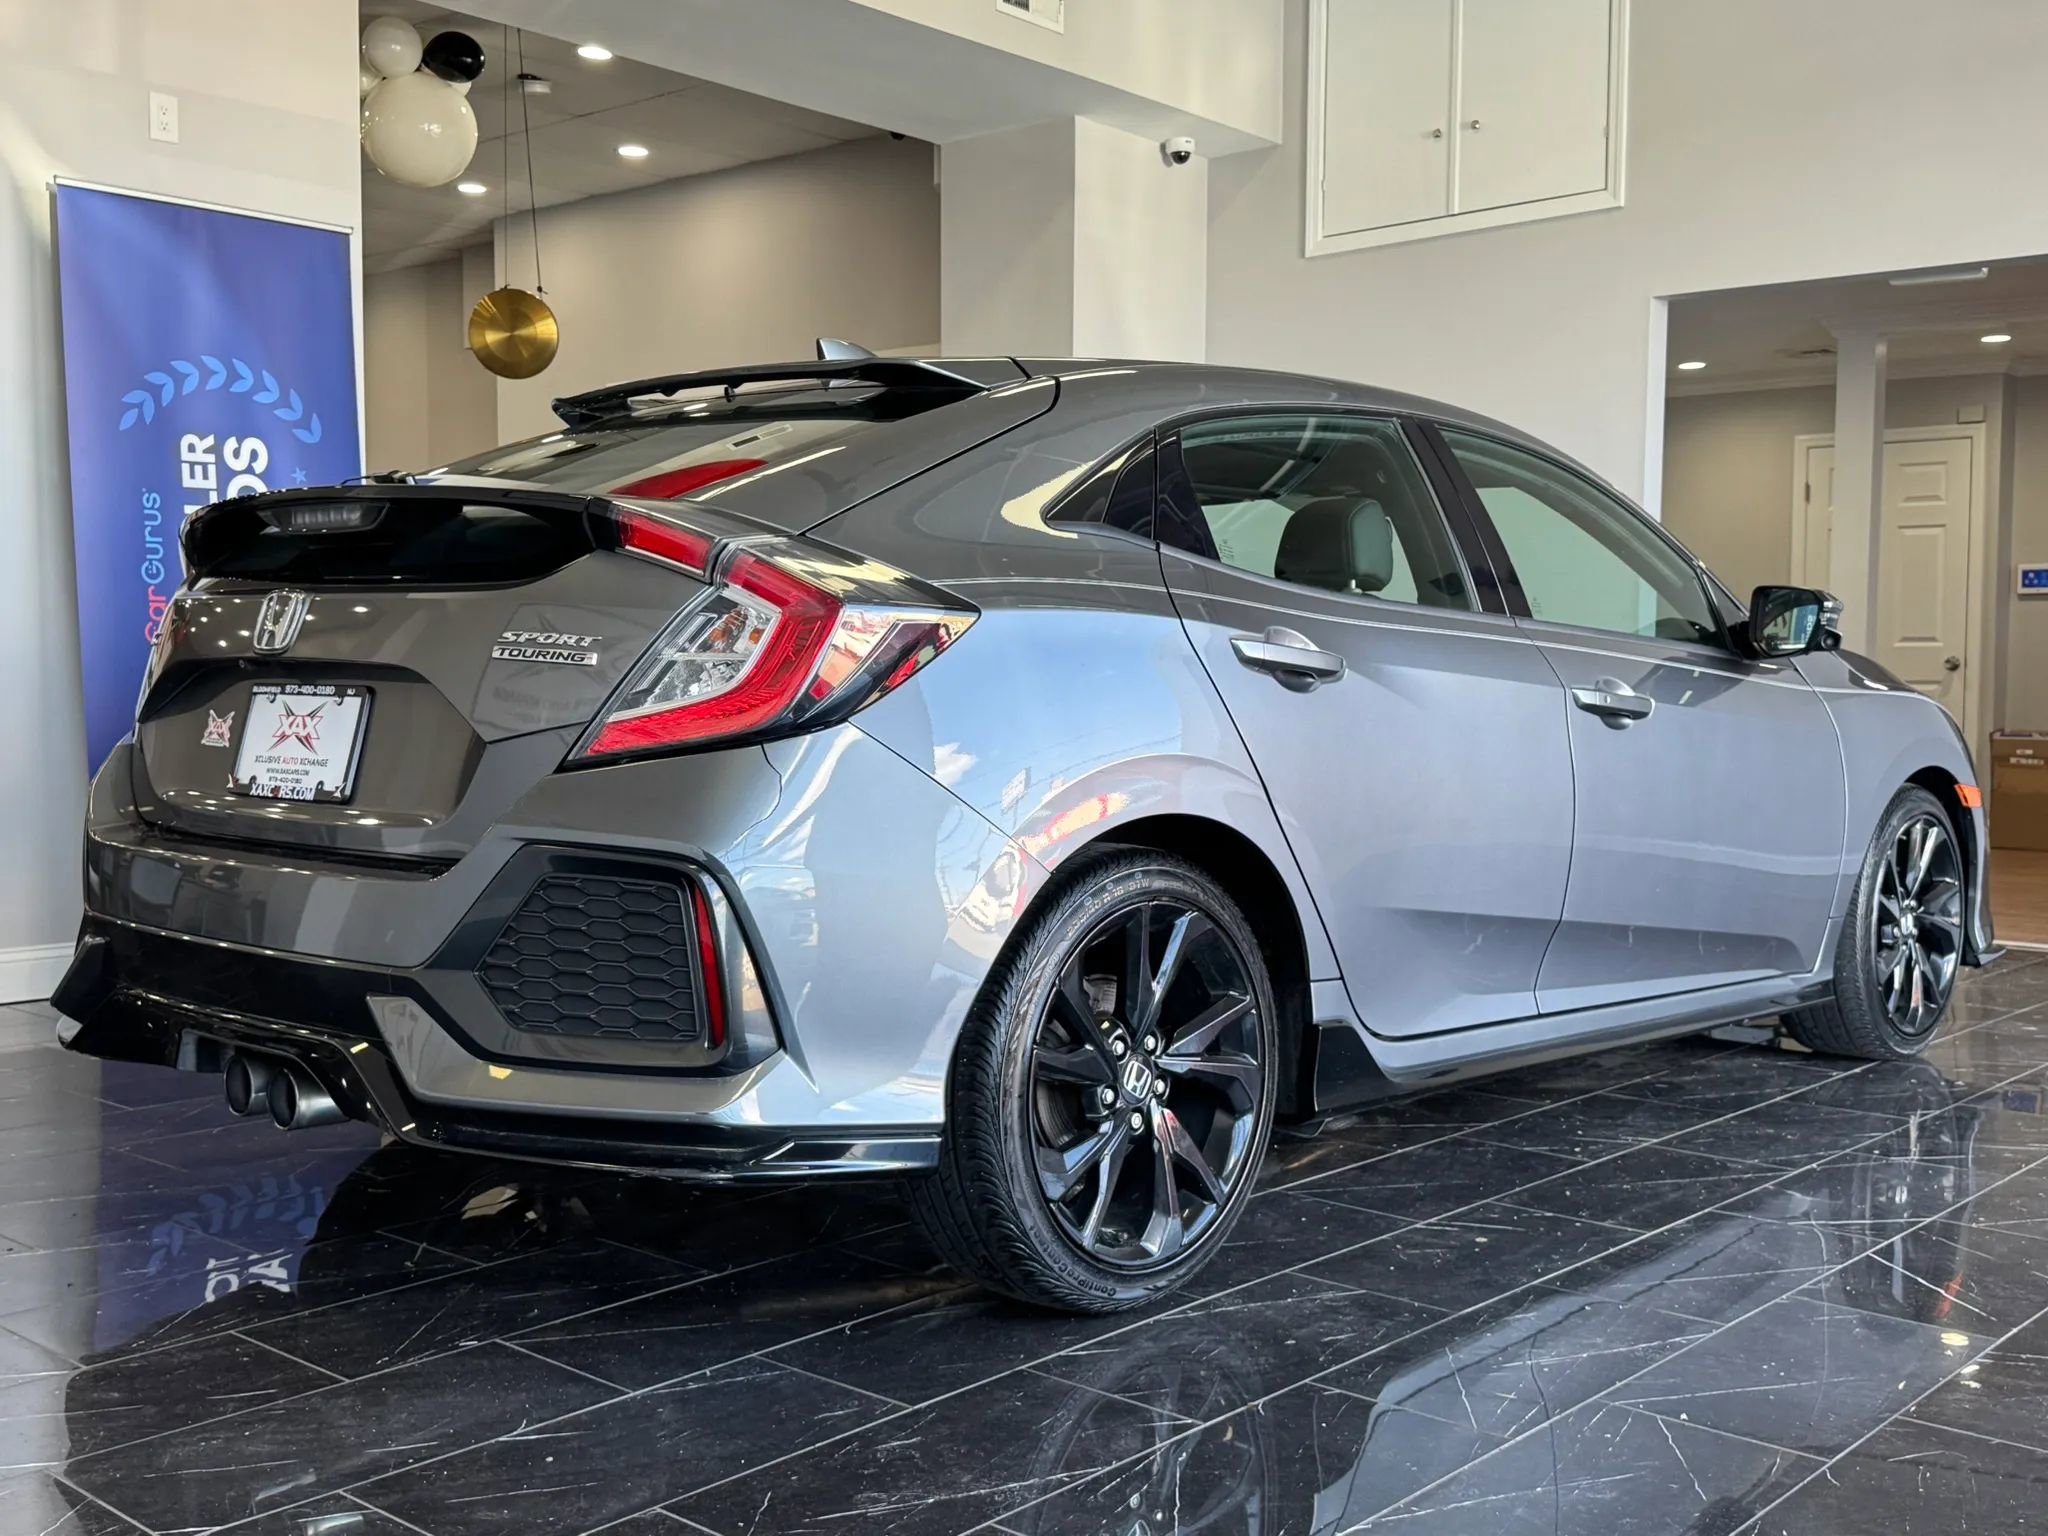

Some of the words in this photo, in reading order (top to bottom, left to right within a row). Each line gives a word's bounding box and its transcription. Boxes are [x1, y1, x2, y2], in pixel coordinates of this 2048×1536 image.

[497, 630, 602, 646] SPORT
[496, 647, 588, 663] TOURING
[285, 685, 336, 695] 973-400-0180
[272, 714, 323, 740] XAX
[255, 755, 282, 765] XCLUSIVE
[282, 756, 299, 765] AUTO
[299, 757, 329, 768] XCHANGE
